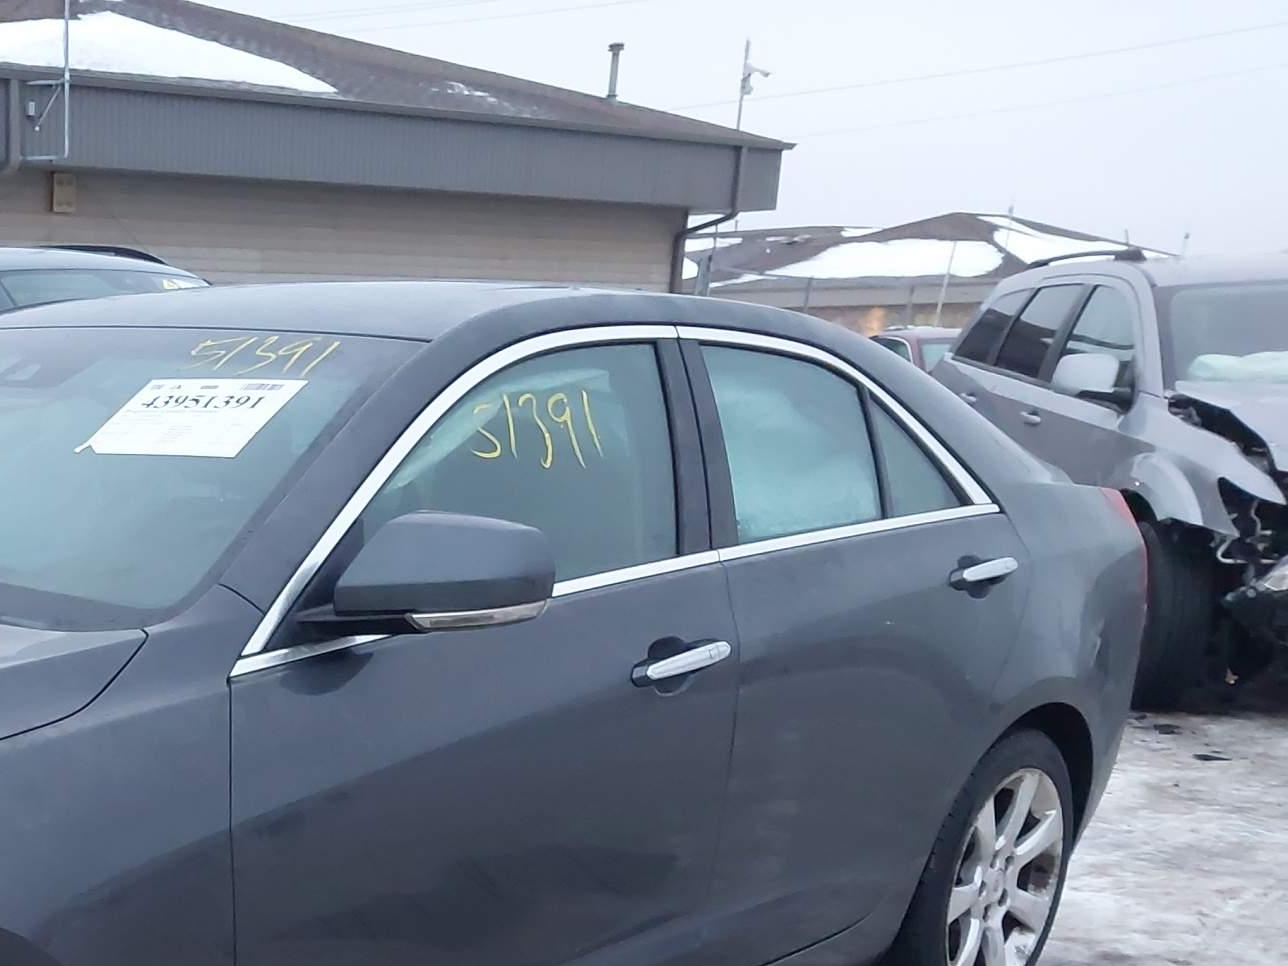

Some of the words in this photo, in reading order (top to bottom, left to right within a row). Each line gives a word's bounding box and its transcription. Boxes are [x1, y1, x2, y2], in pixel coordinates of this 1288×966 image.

[181, 335, 341, 378] 51391
[141, 394, 265, 409] 43951391
[471, 389, 604, 470] 51391
